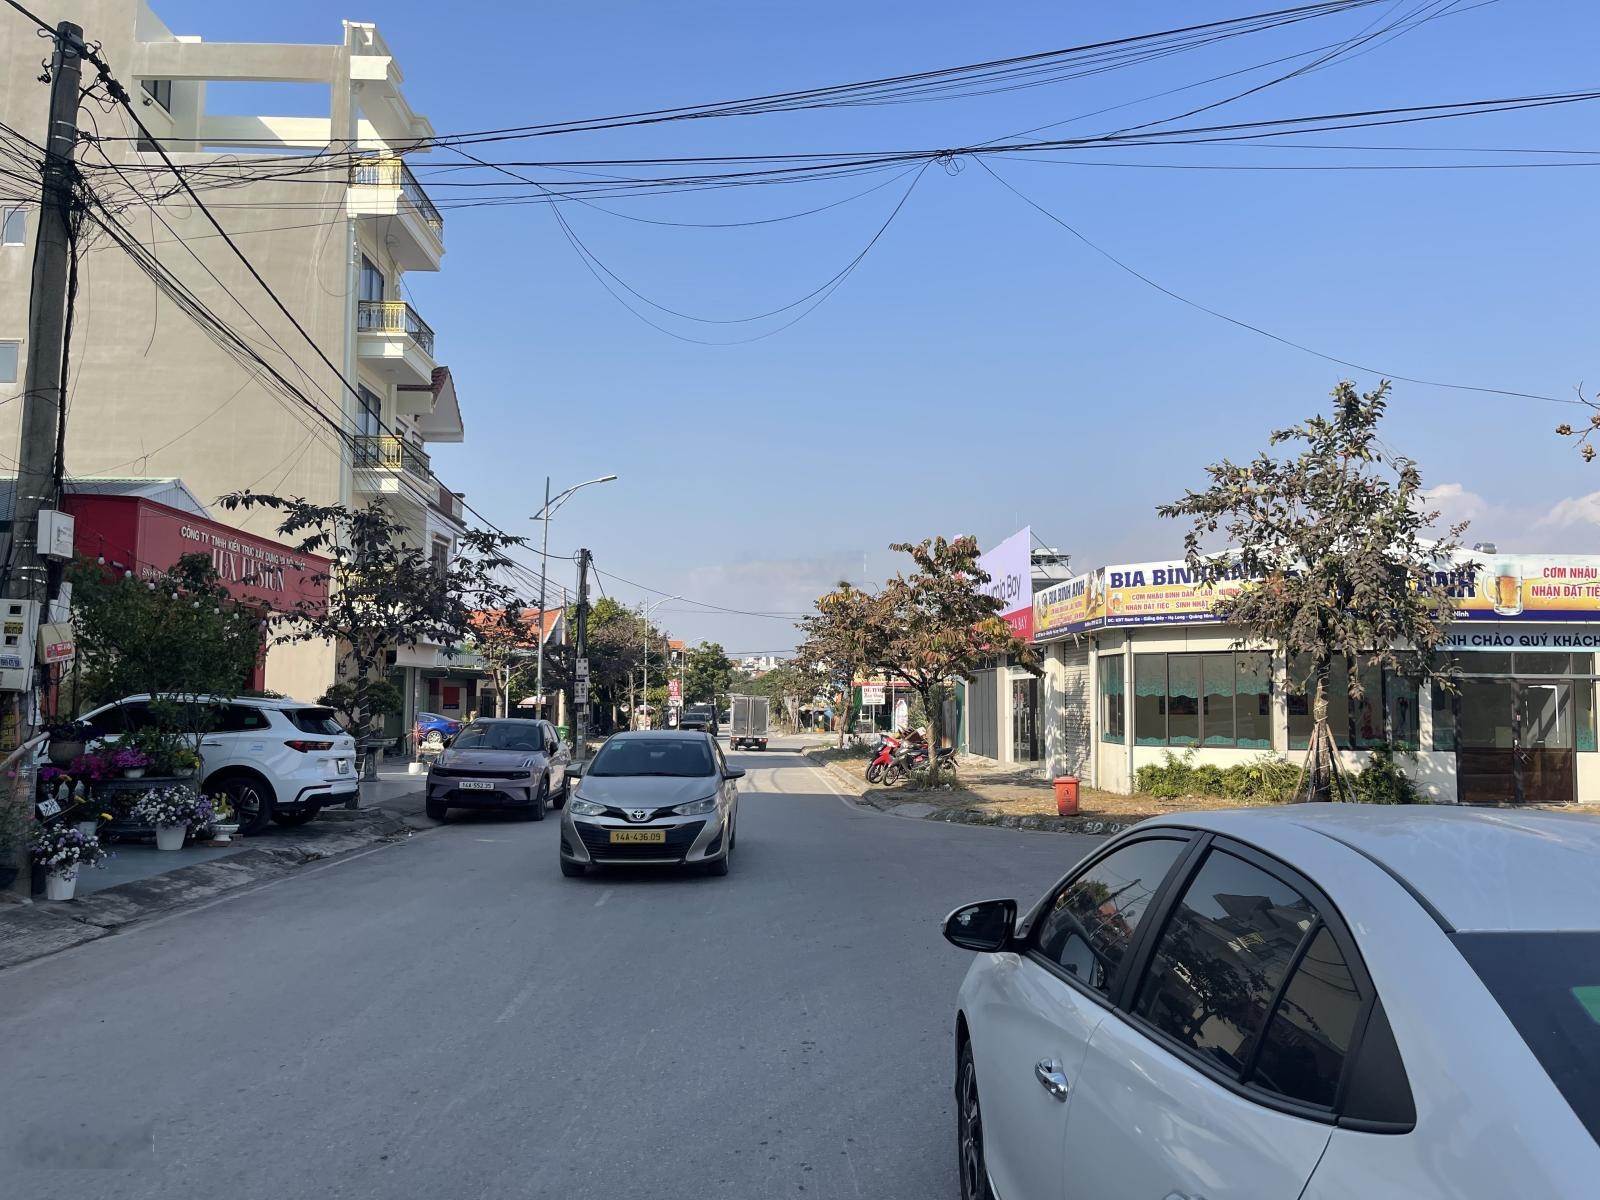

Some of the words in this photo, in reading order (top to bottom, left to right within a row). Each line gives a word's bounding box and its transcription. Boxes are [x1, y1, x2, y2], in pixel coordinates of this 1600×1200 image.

[181, 524, 200, 541] CÔNG
[201, 531, 210, 543] TY
[1109, 570, 1146, 589] BIA
[1543, 566, 1567, 578] CƠM
[1569, 565, 1598, 581] NHẬU
[1006, 573, 1021, 600] Bay
[1531, 583, 1561, 599] NHẬN
[1563, 584, 1583, 599] ĐẶT
[1132, 593, 1146, 601] CƠM
[1175, 601, 1191, 609] SINH
[1471, 631, 1515, 647] CHÀO
[1518, 632, 1549, 647] QUÝ
[615, 832, 661, 841] 14A-436.09
